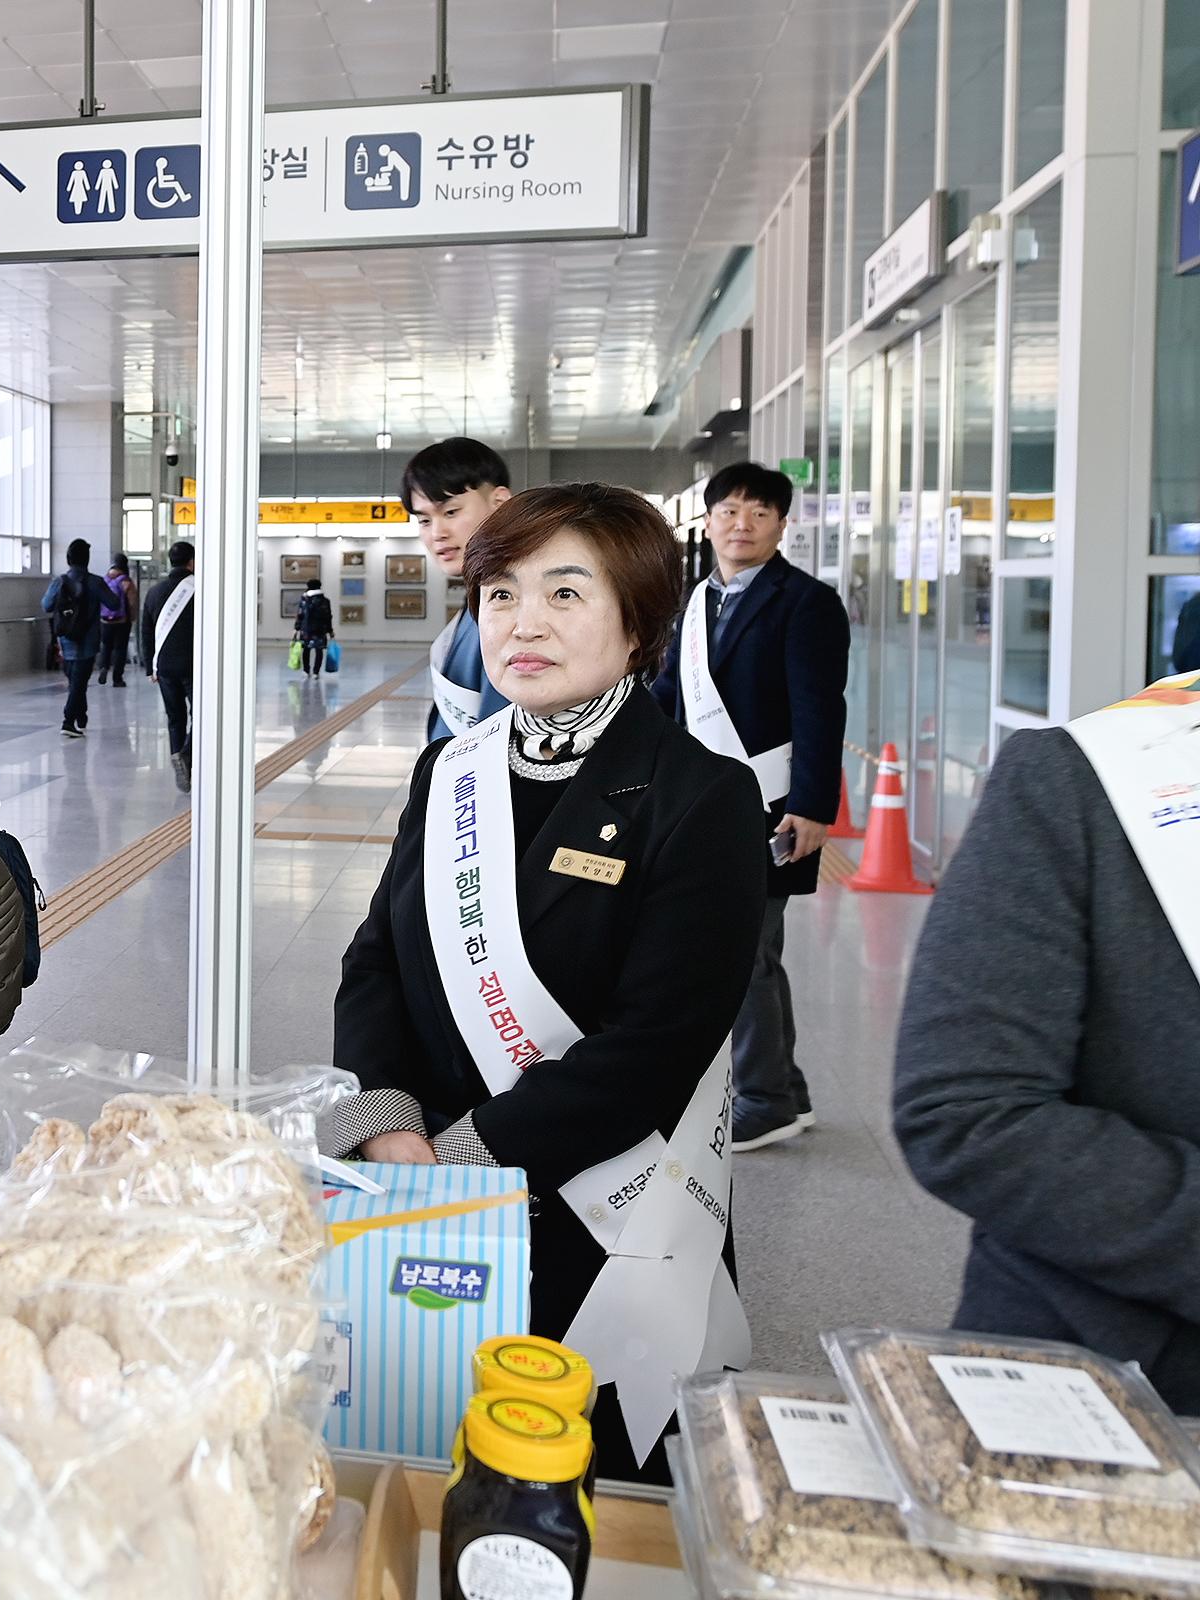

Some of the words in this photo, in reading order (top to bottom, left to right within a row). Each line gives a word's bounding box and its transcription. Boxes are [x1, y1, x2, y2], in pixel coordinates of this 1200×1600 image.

[262, 146, 308, 182] 장실
[436, 133, 536, 173] 수유방
[435, 180, 514, 204] Nursing
[520, 177, 583, 200] Room
[373, 506, 385, 518] 4
[454, 770, 480, 863] 즐겁고
[478, 970, 544, 1071] 설명절
